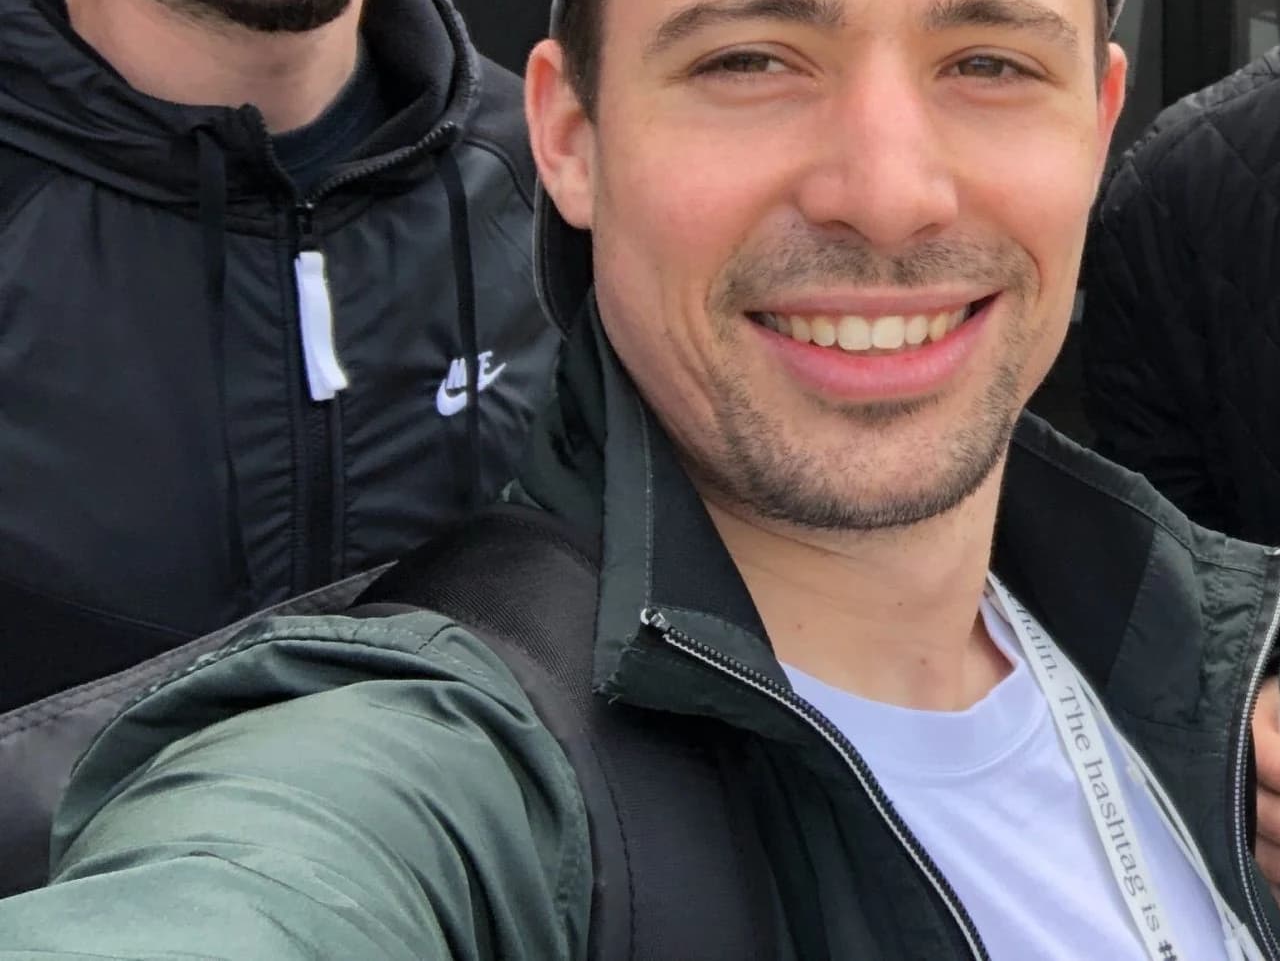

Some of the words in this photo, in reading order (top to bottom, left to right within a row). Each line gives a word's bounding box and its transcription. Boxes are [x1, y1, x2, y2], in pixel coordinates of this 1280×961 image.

[1059, 685, 1090, 751] The
[1084, 758, 1147, 897] hashtag
[1142, 903, 1160, 932] is
